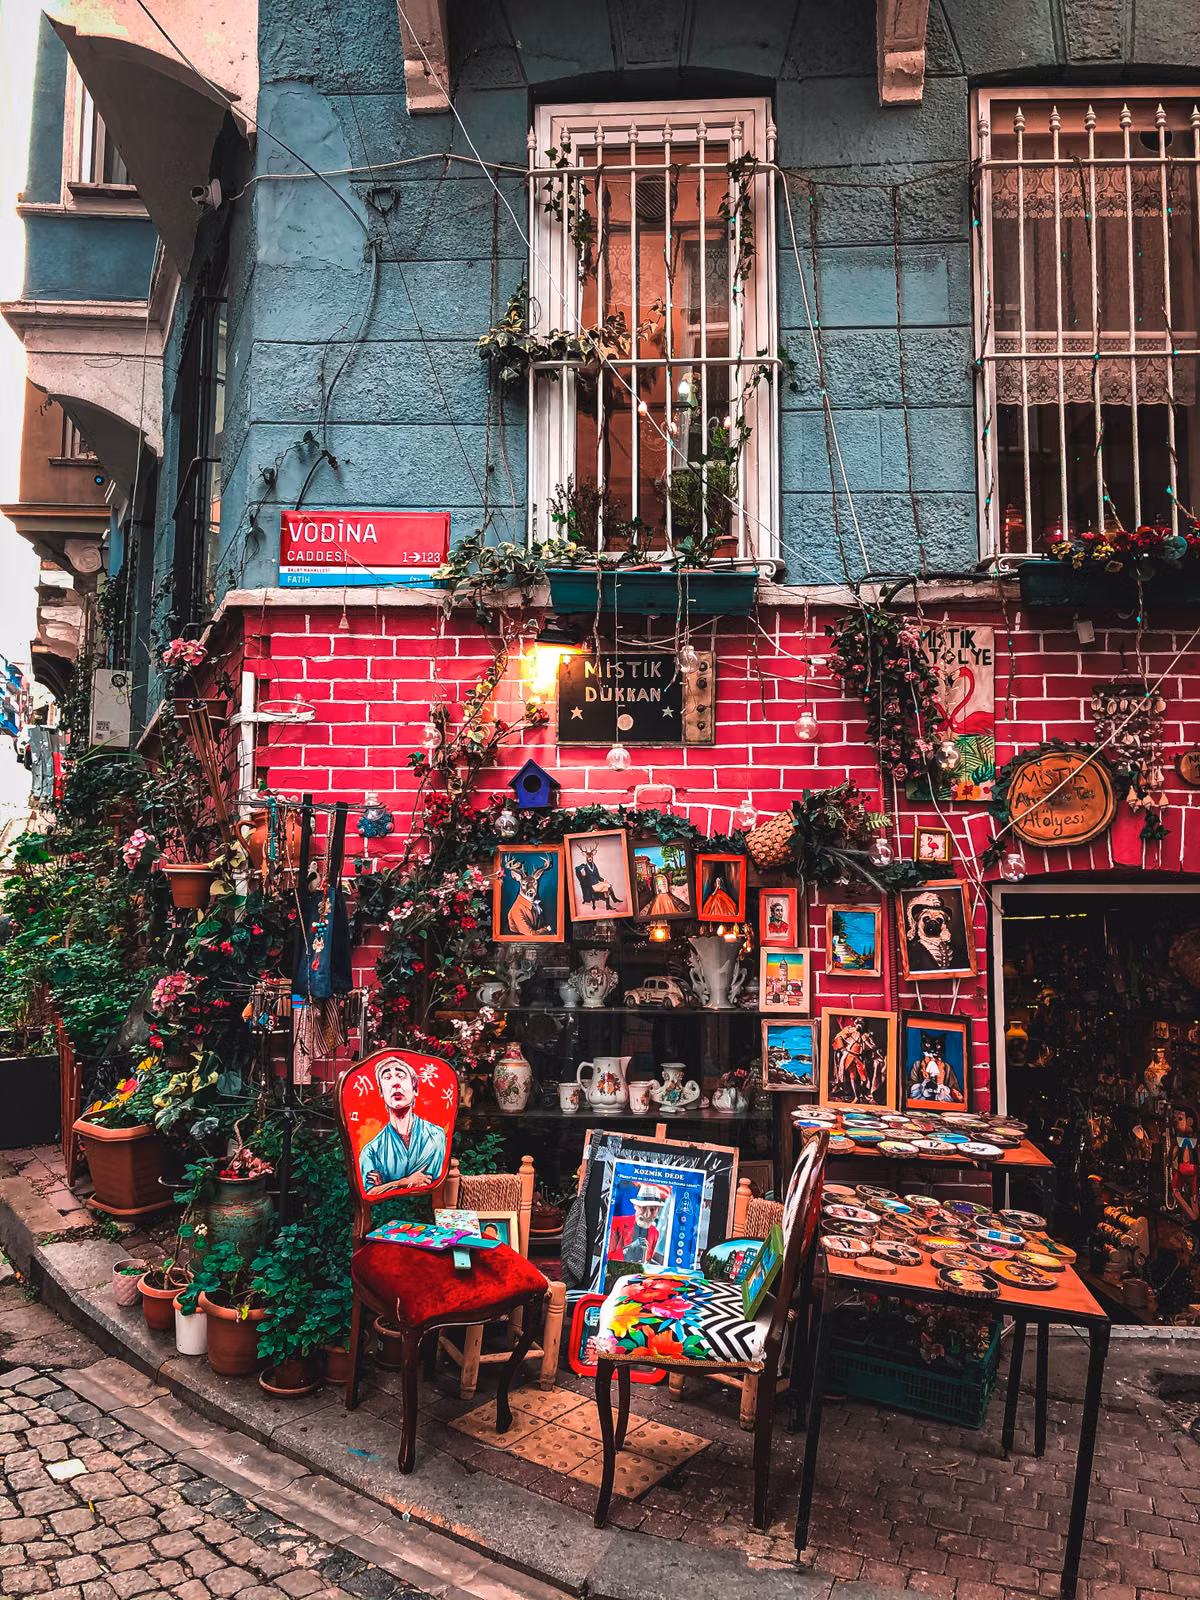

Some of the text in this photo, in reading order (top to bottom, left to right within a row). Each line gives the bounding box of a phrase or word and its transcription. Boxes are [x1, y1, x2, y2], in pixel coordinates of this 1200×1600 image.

[288, 519, 378, 543] VODİNA
[421, 552, 441, 563] 123
[287, 575, 311, 584] FATİH
[584, 658, 662, 678] MİSTİK
[585, 684, 661, 702] DÜKKAN
[634, 1167, 685, 1180] KOZMİK DEDE
